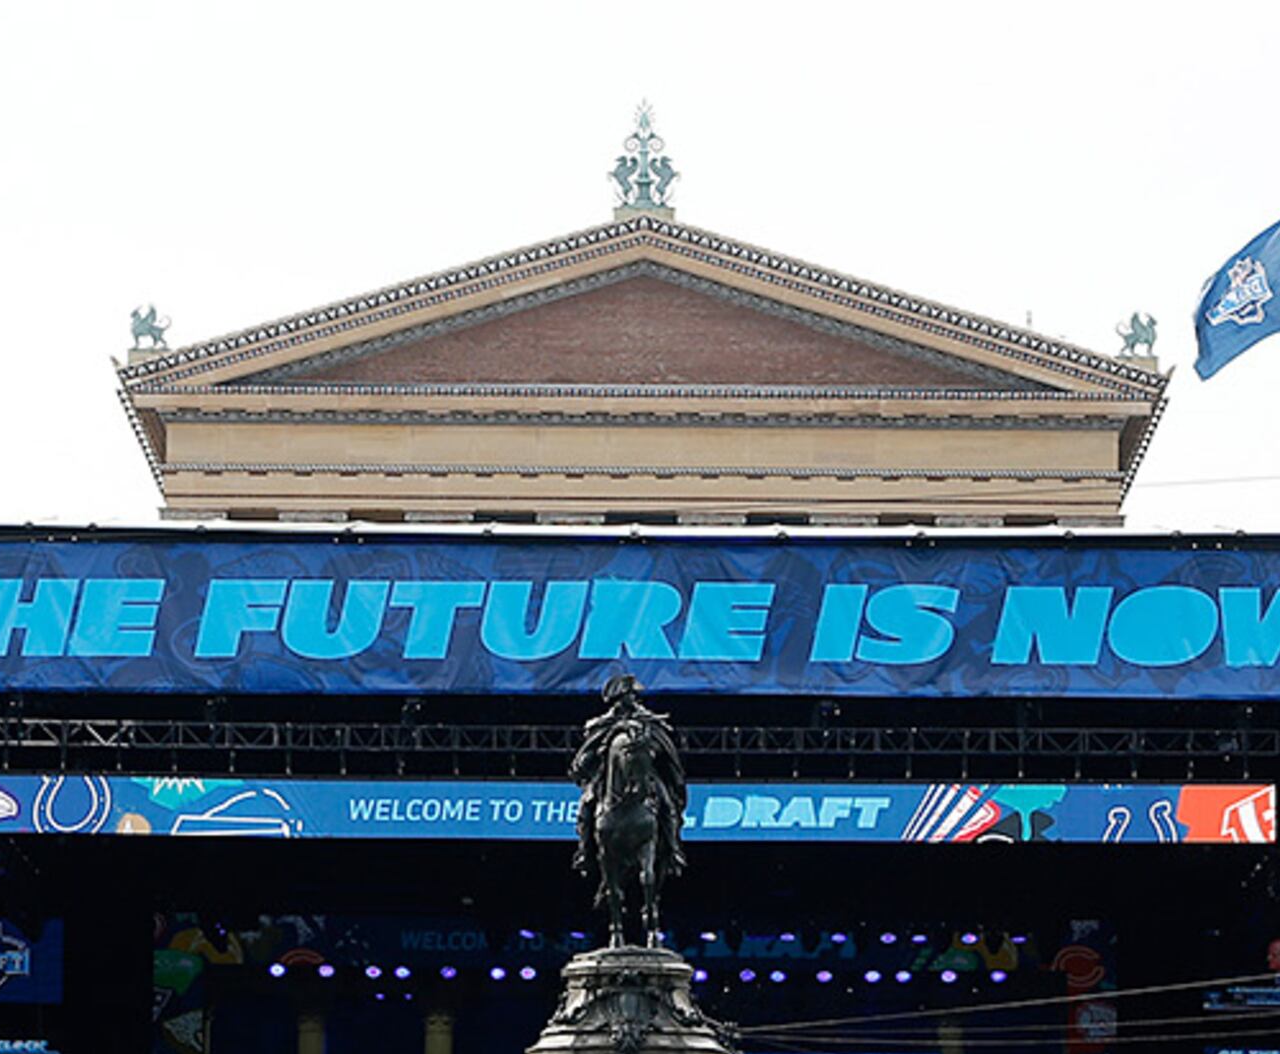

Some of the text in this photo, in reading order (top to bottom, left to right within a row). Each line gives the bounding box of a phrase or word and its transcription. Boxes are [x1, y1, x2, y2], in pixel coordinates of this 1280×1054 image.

[194, 579, 776, 662] FUTURE
[811, 584, 960, 664] IS
[349, 798, 579, 823] WELCOME TO THE
[703, 798, 891, 829] DRAFT
